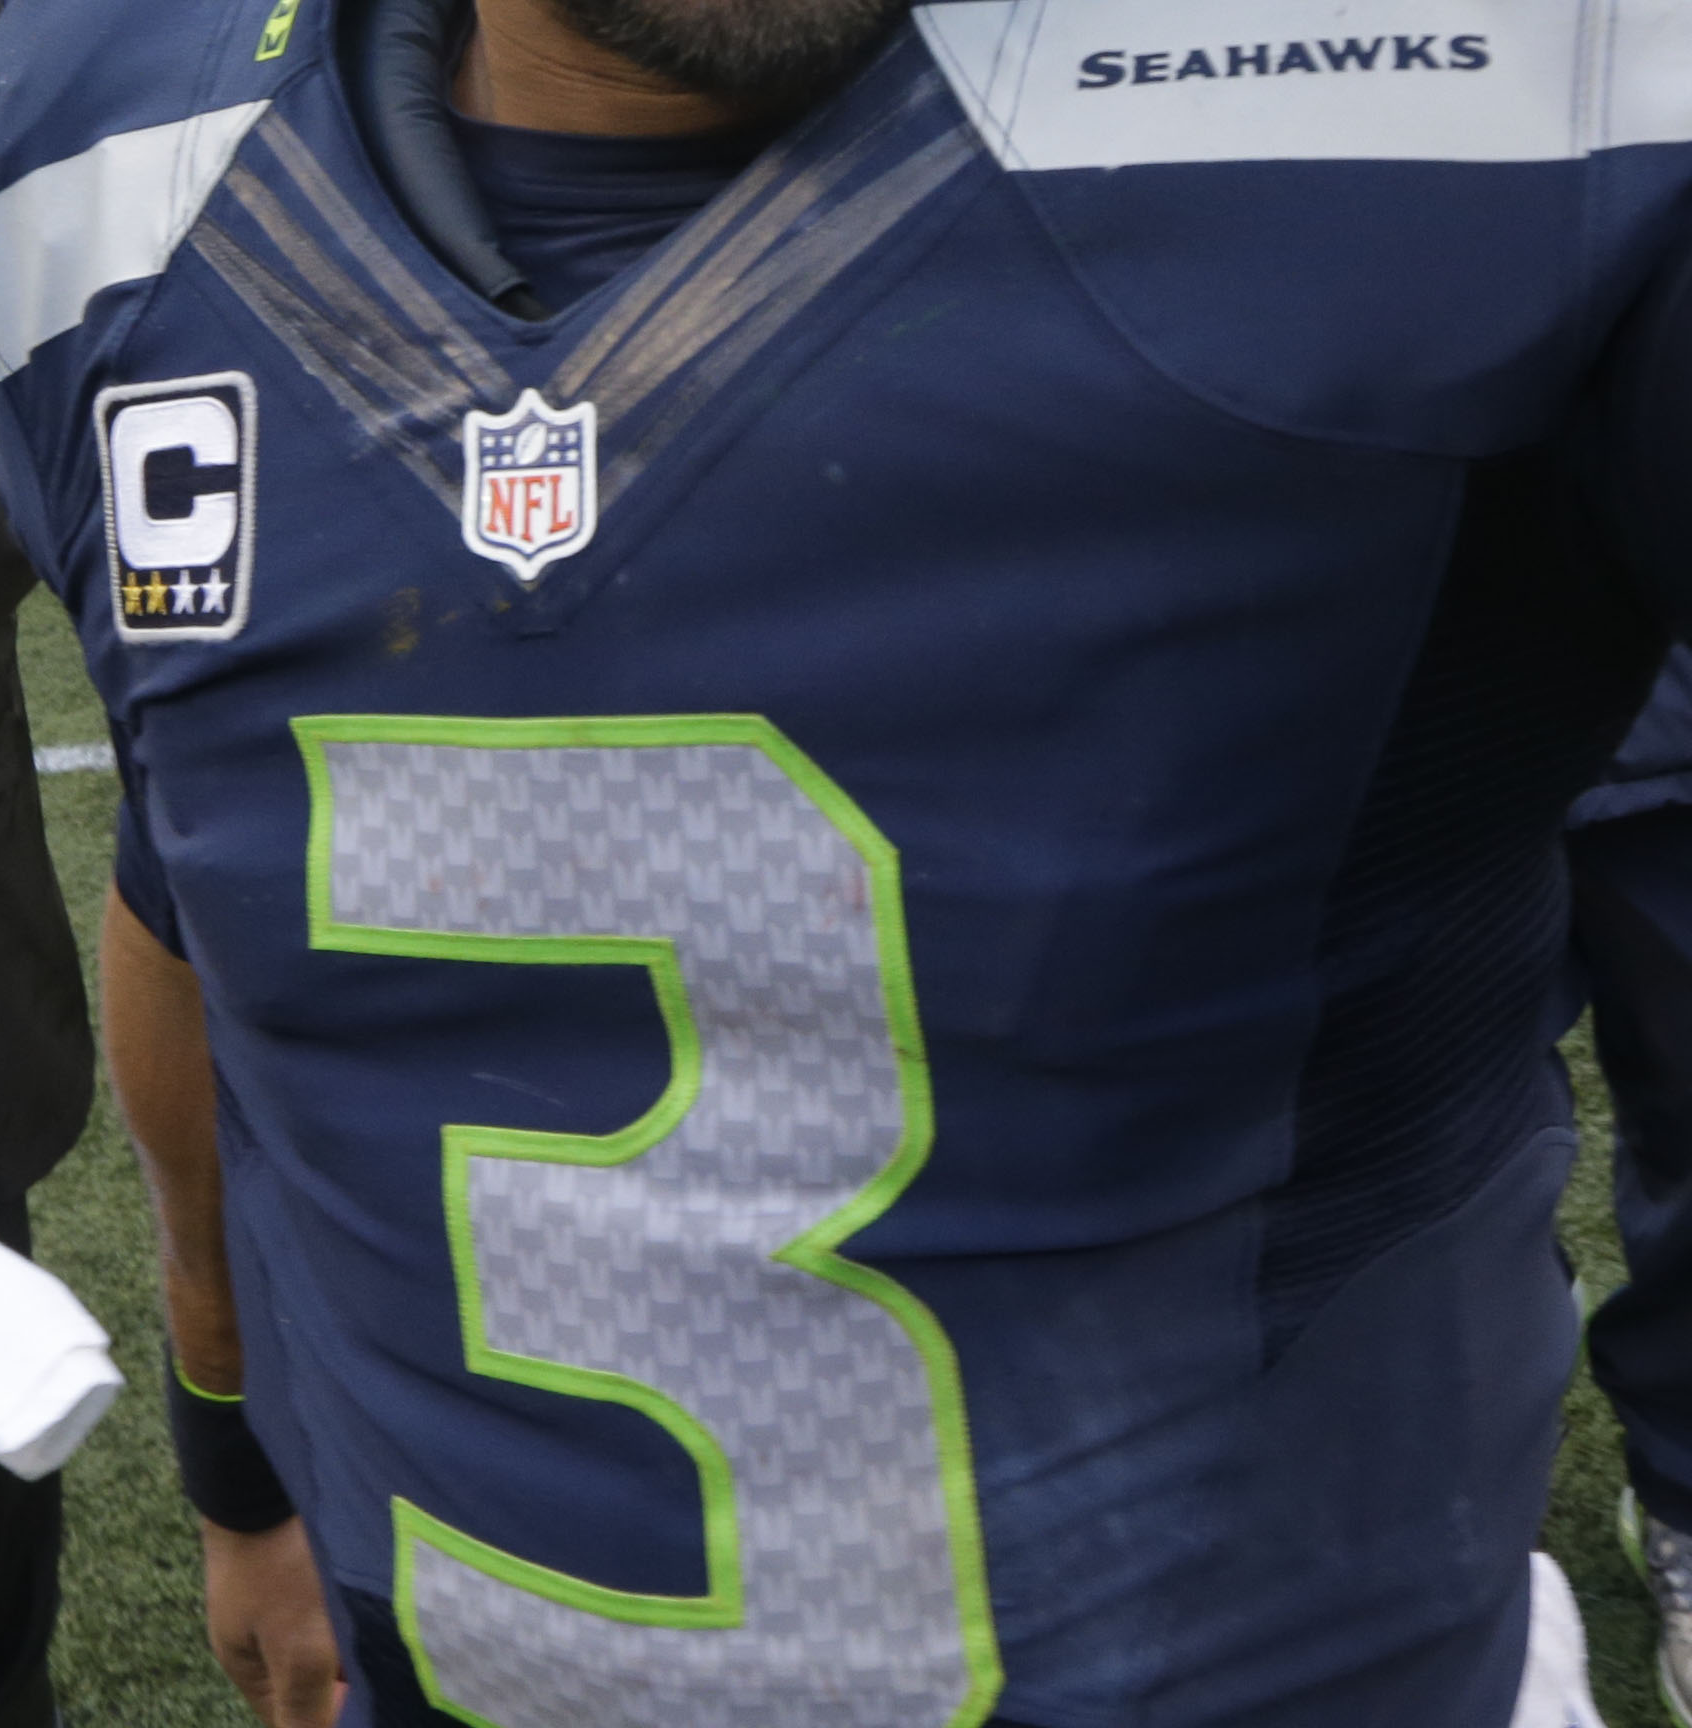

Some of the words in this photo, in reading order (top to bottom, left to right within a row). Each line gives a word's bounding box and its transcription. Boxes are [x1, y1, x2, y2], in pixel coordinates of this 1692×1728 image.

[1077, 34, 1491, 89] SEAHAWKS
[110, 395, 238, 569] C
[485, 474, 572, 543] NFL
[290, 713, 1002, 1728] 3
